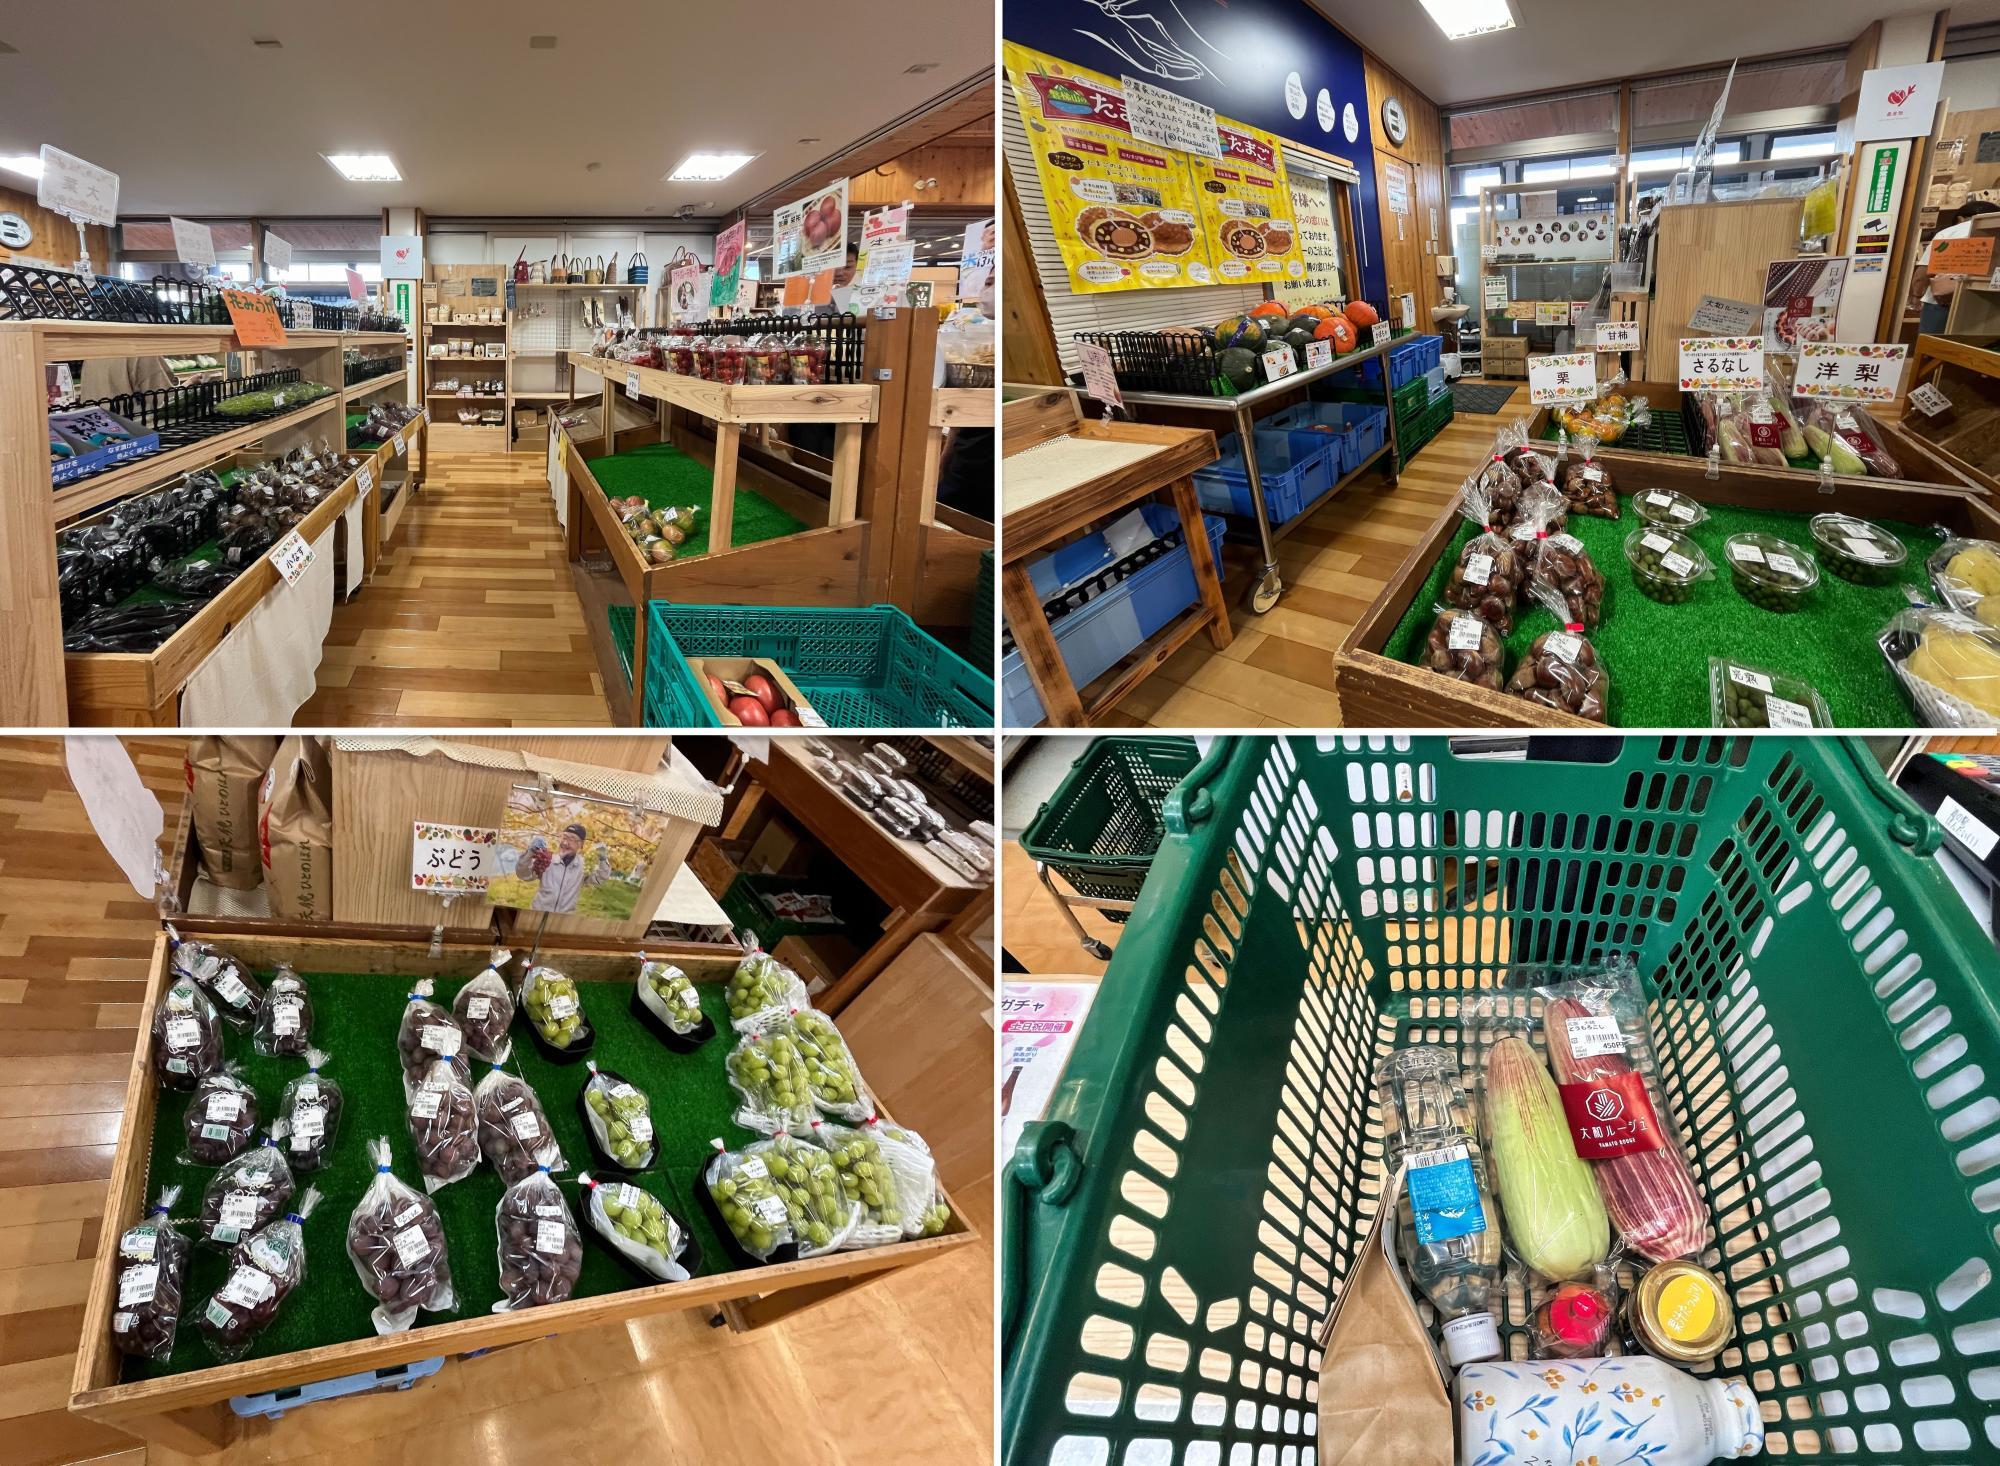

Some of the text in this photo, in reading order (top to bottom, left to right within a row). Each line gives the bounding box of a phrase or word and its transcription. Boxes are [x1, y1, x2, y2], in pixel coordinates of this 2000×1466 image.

[1228, 134, 1269, 160] たまご
[1608, 330, 1628, 340] 甘柿
[1693, 358, 1749, 373] さるなし
[1557, 372, 1570, 384] 栗
[427, 848, 480, 870] ぶどう
[1010, 1022, 1064, 1031] 土日祝開催
[1569, 1024, 1604, 1032] とうもろこし
[1580, 1117, 1648, 1140] 大和ルージュ
